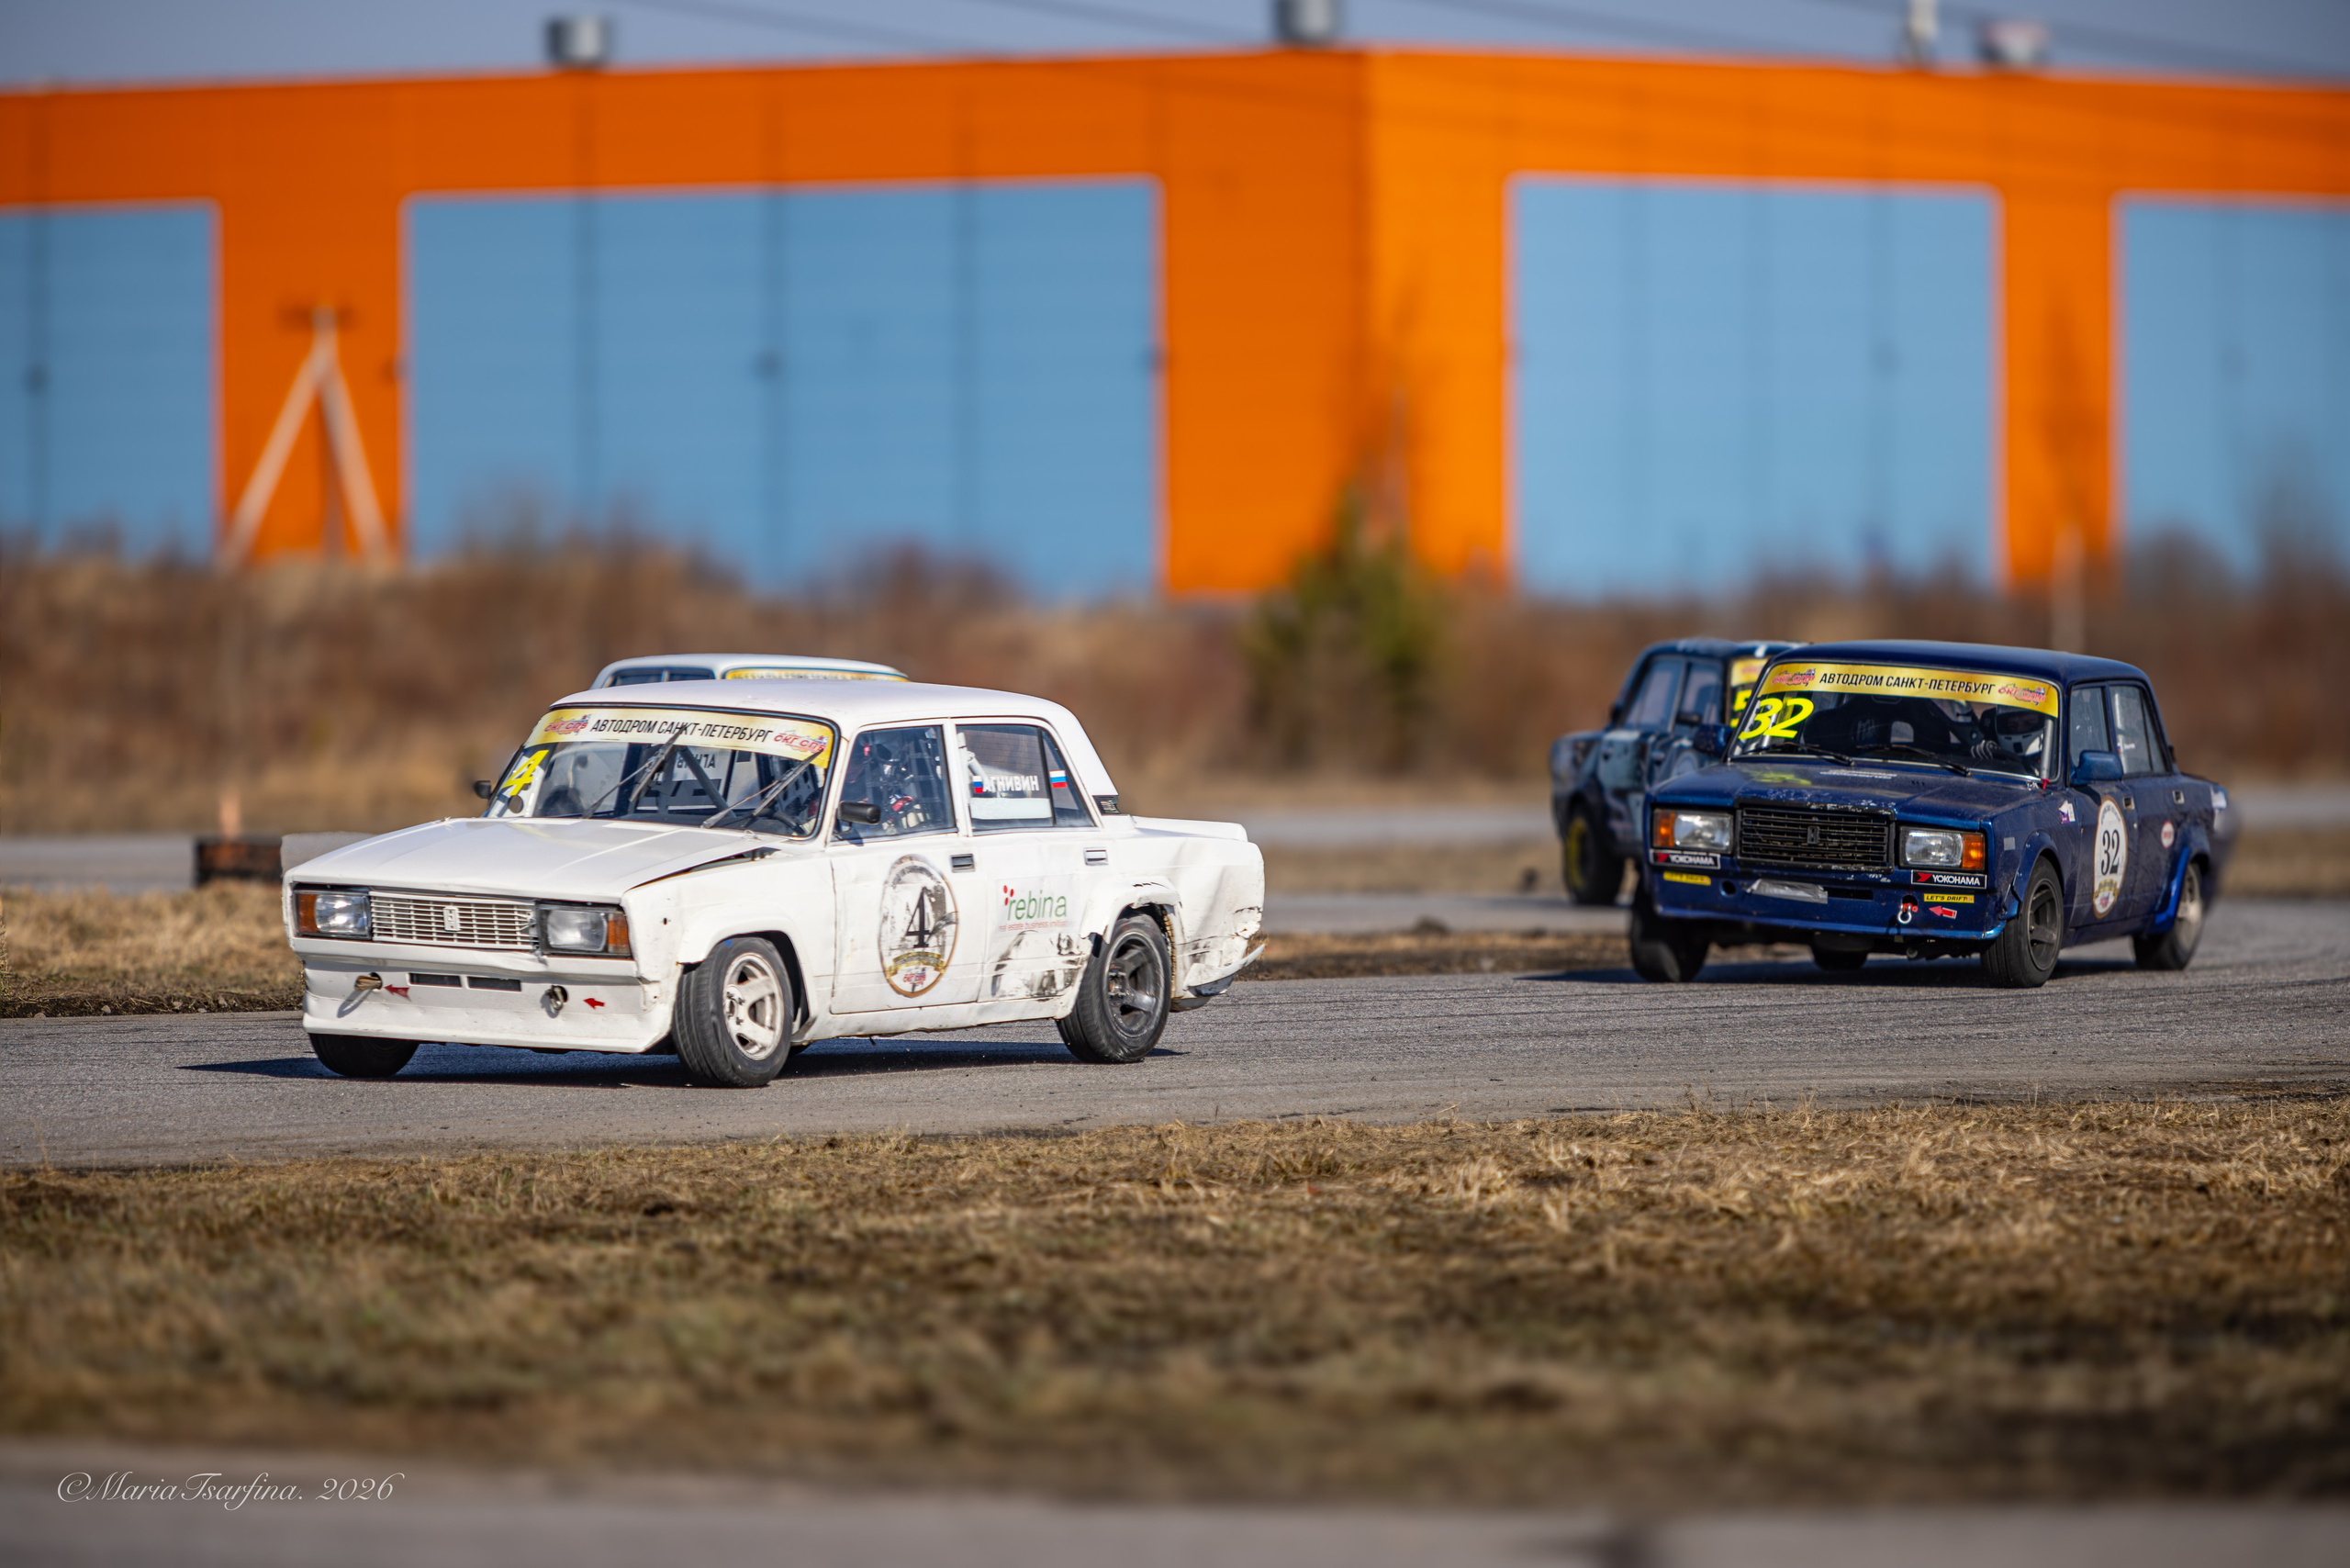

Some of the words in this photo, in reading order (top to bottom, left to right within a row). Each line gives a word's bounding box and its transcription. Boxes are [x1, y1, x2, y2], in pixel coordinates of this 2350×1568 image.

[1819, 673, 1884, 686] АВТОДРОМ
[1886, 676, 1996, 695] САНКТ-ПЕТЕРБУРГ
[590, 719, 658, 734] АВТОДРОМ
[657, 720, 774, 743] САНКТ-ПЕТЕРБУРГ
[1739, 698, 1814, 739] 32
[501, 749, 549, 796] 4
[983, 775, 1040, 792] АГНИВИН
[1670, 854, 1715, 866] YOKOHAMA
[2100, 829, 2121, 876] 32
[1932, 874, 1981, 886] YOKOHAMA
[905, 886, 930, 948] 4
[1007, 889, 1068, 921] rebina
